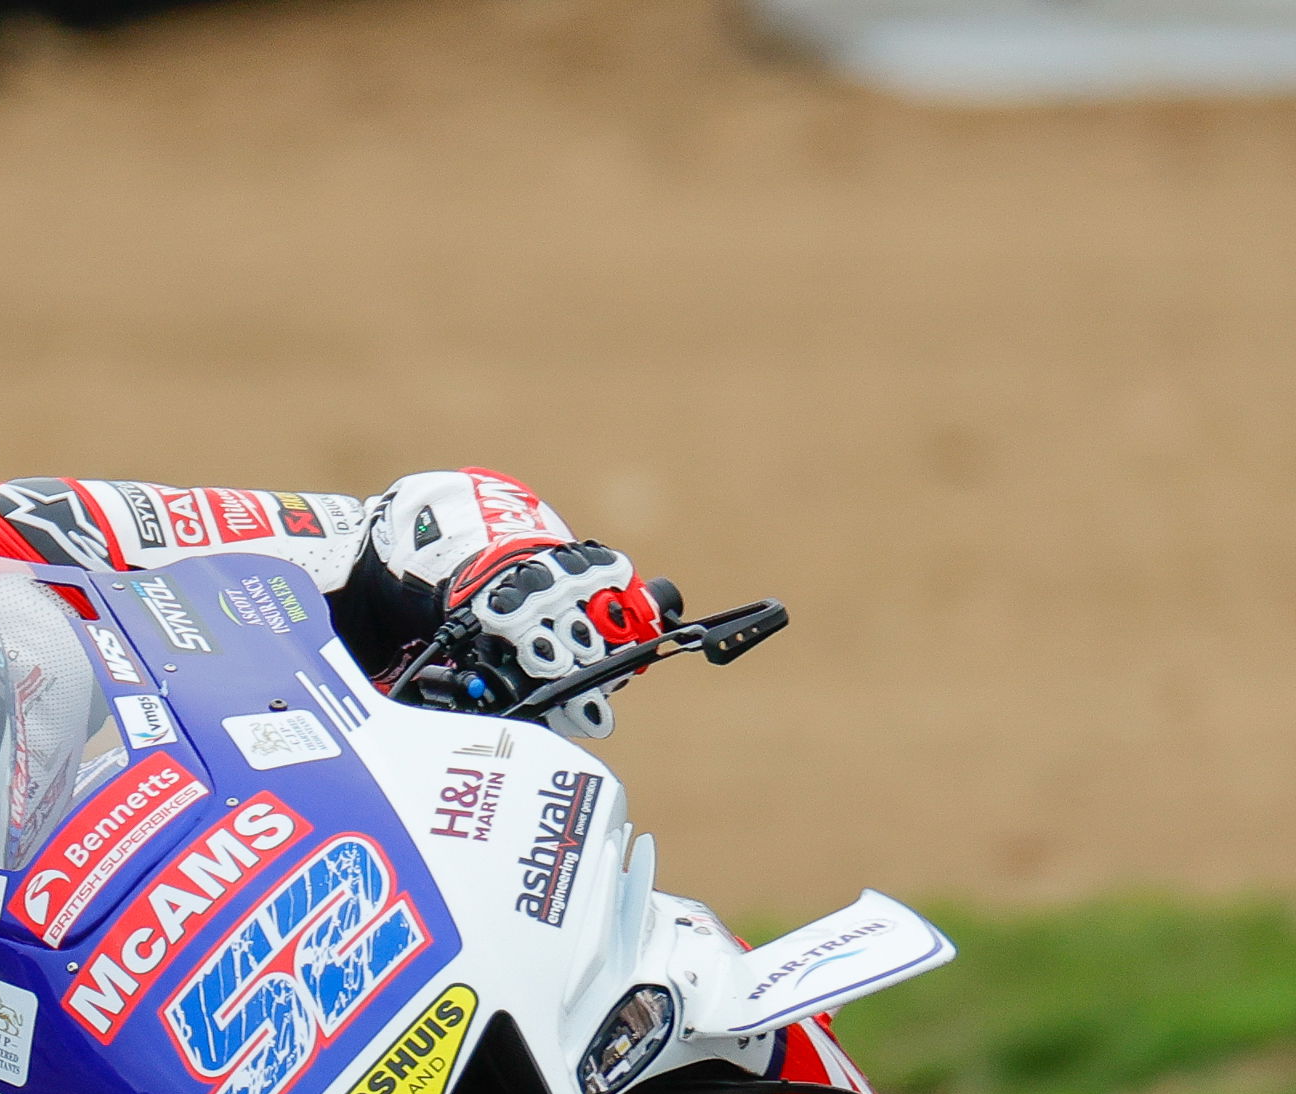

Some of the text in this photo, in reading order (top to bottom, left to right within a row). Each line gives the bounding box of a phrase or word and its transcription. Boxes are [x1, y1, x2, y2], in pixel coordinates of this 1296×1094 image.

[140, 577, 212, 653] SYNTOL
[225, 588, 265, 627] ASCOTT
[241, 576, 292, 635] INSURANCE
[267, 576, 309, 624] BROKERS
[86, 624, 142, 684] WRS
[137, 695, 162, 732] vmgs
[63, 767, 181, 869] Bennetts
[430, 767, 484, 839] H&J
[473, 772, 506, 842] MARTIN
[48, 786, 200, 941] BRITISH SUPERBIKES
[515, 770, 579, 920] ashvale
[68, 800, 298, 1036] McAMS
[547, 851, 579, 924] engineering
[747, 922, 887, 1000] MAR-TRAIN
